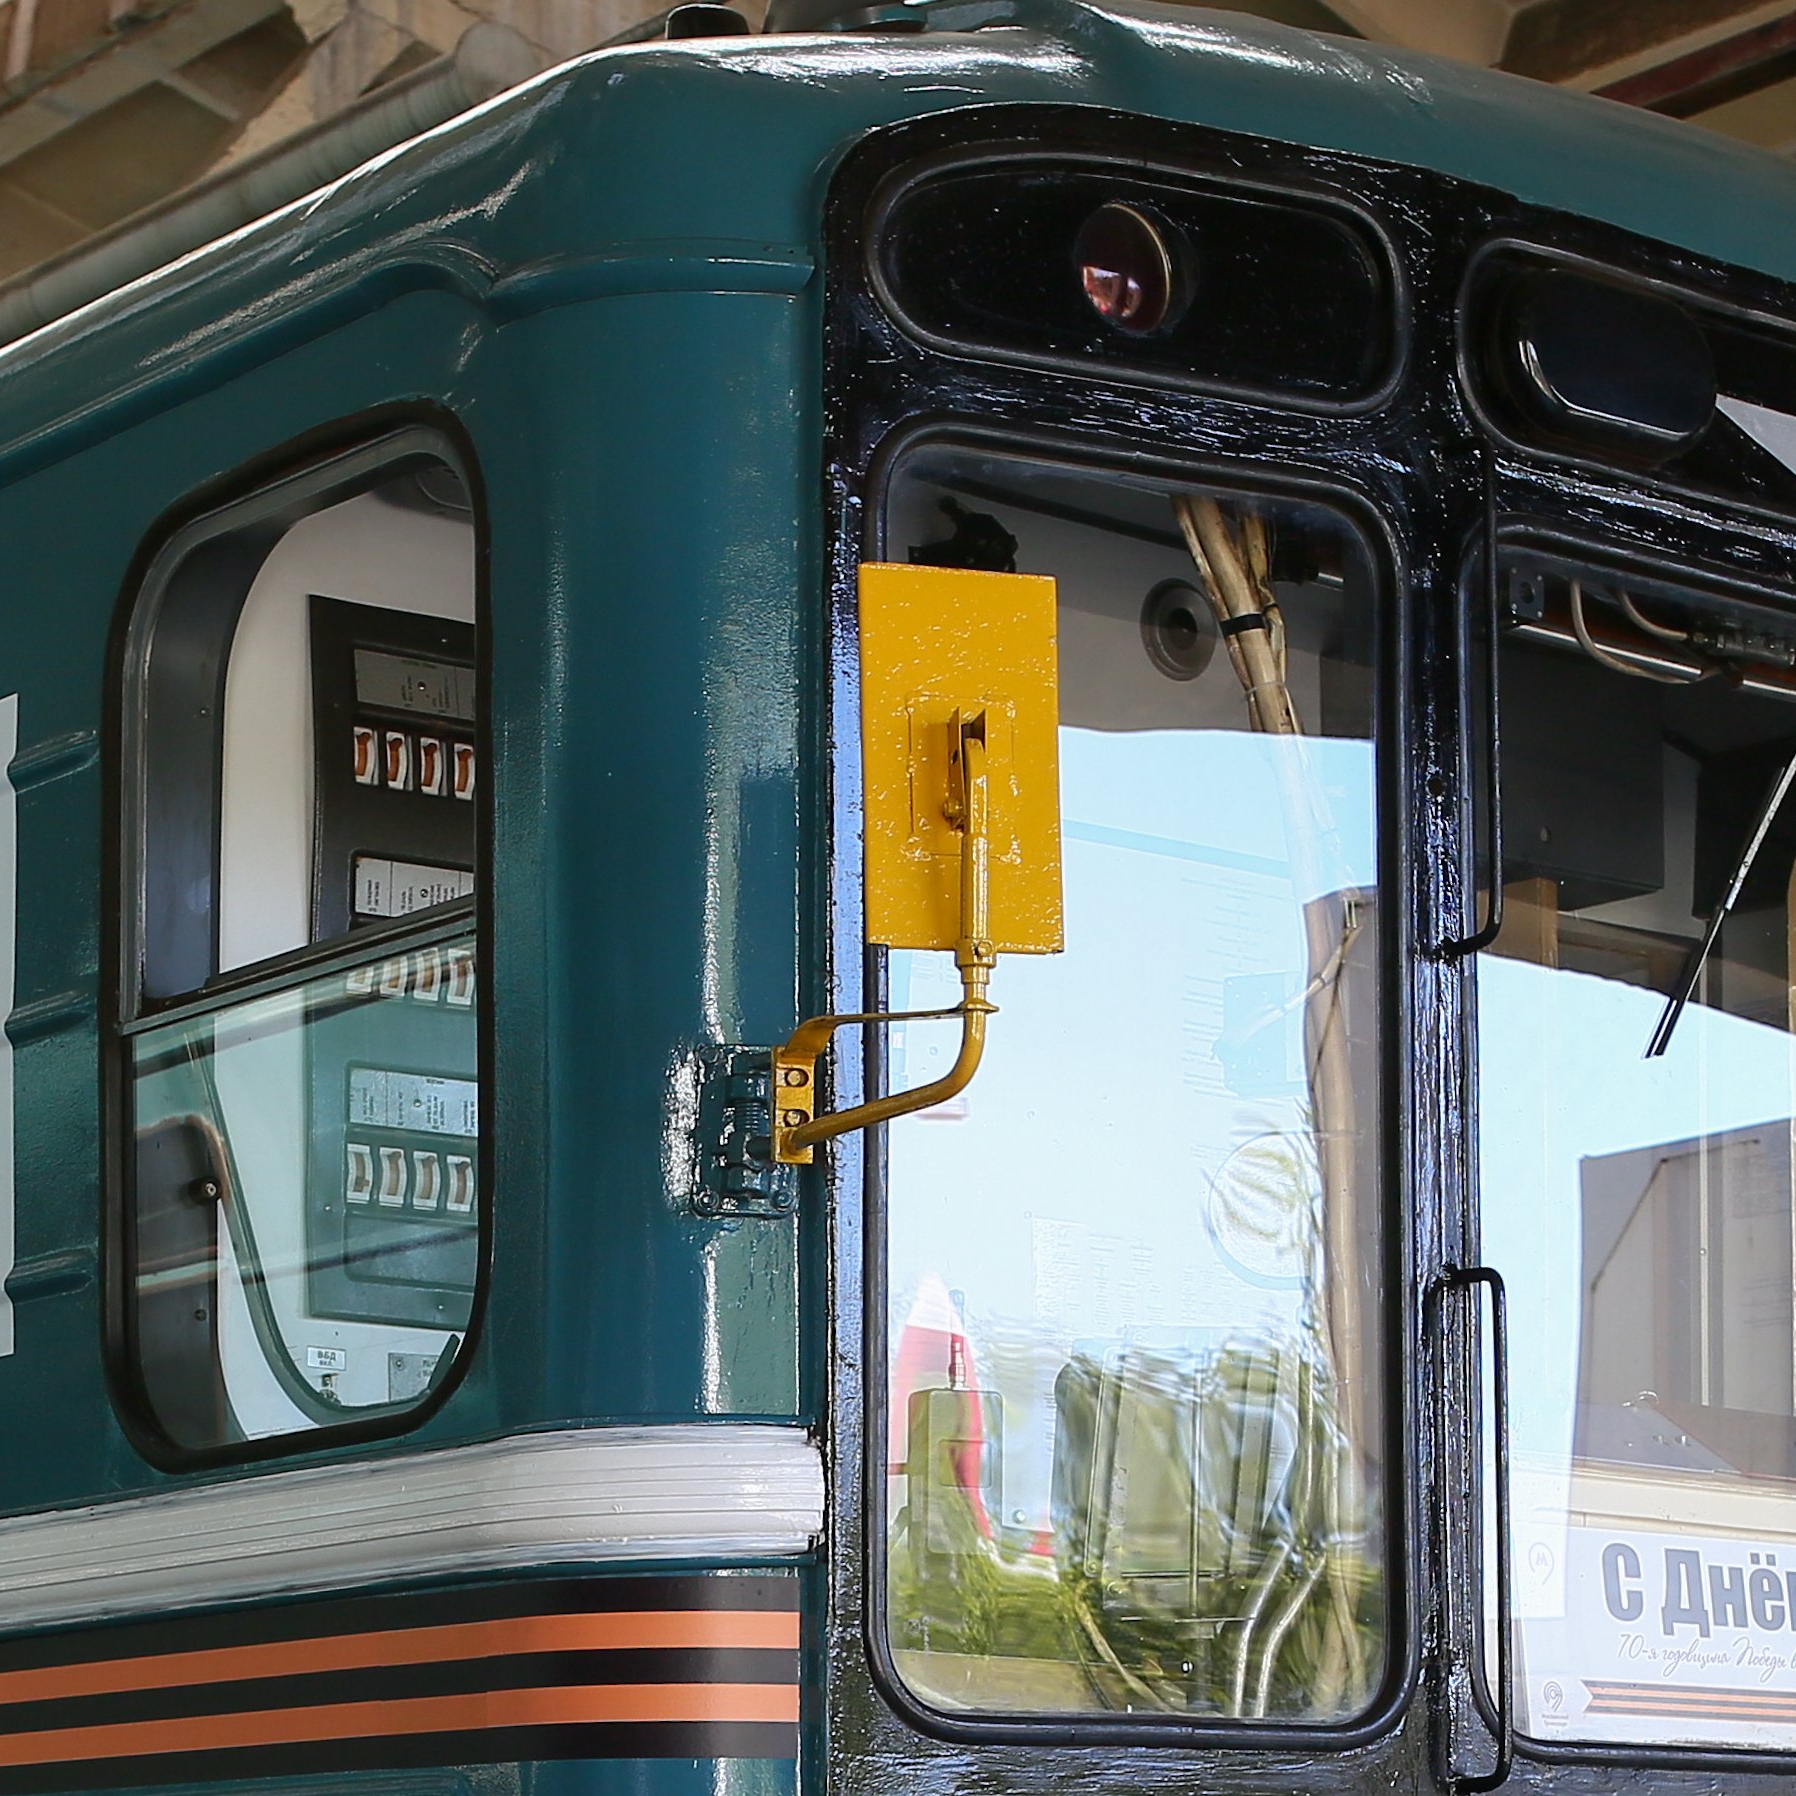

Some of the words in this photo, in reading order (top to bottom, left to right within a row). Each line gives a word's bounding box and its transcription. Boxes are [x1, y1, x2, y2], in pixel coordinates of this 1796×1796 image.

[1603, 1542, 1644, 1622] С
[1617, 1634, 1658, 1659] 70-я
[1662, 1638, 1731, 1677] годовщина
[1732, 1636, 1787, 1683] Победы
